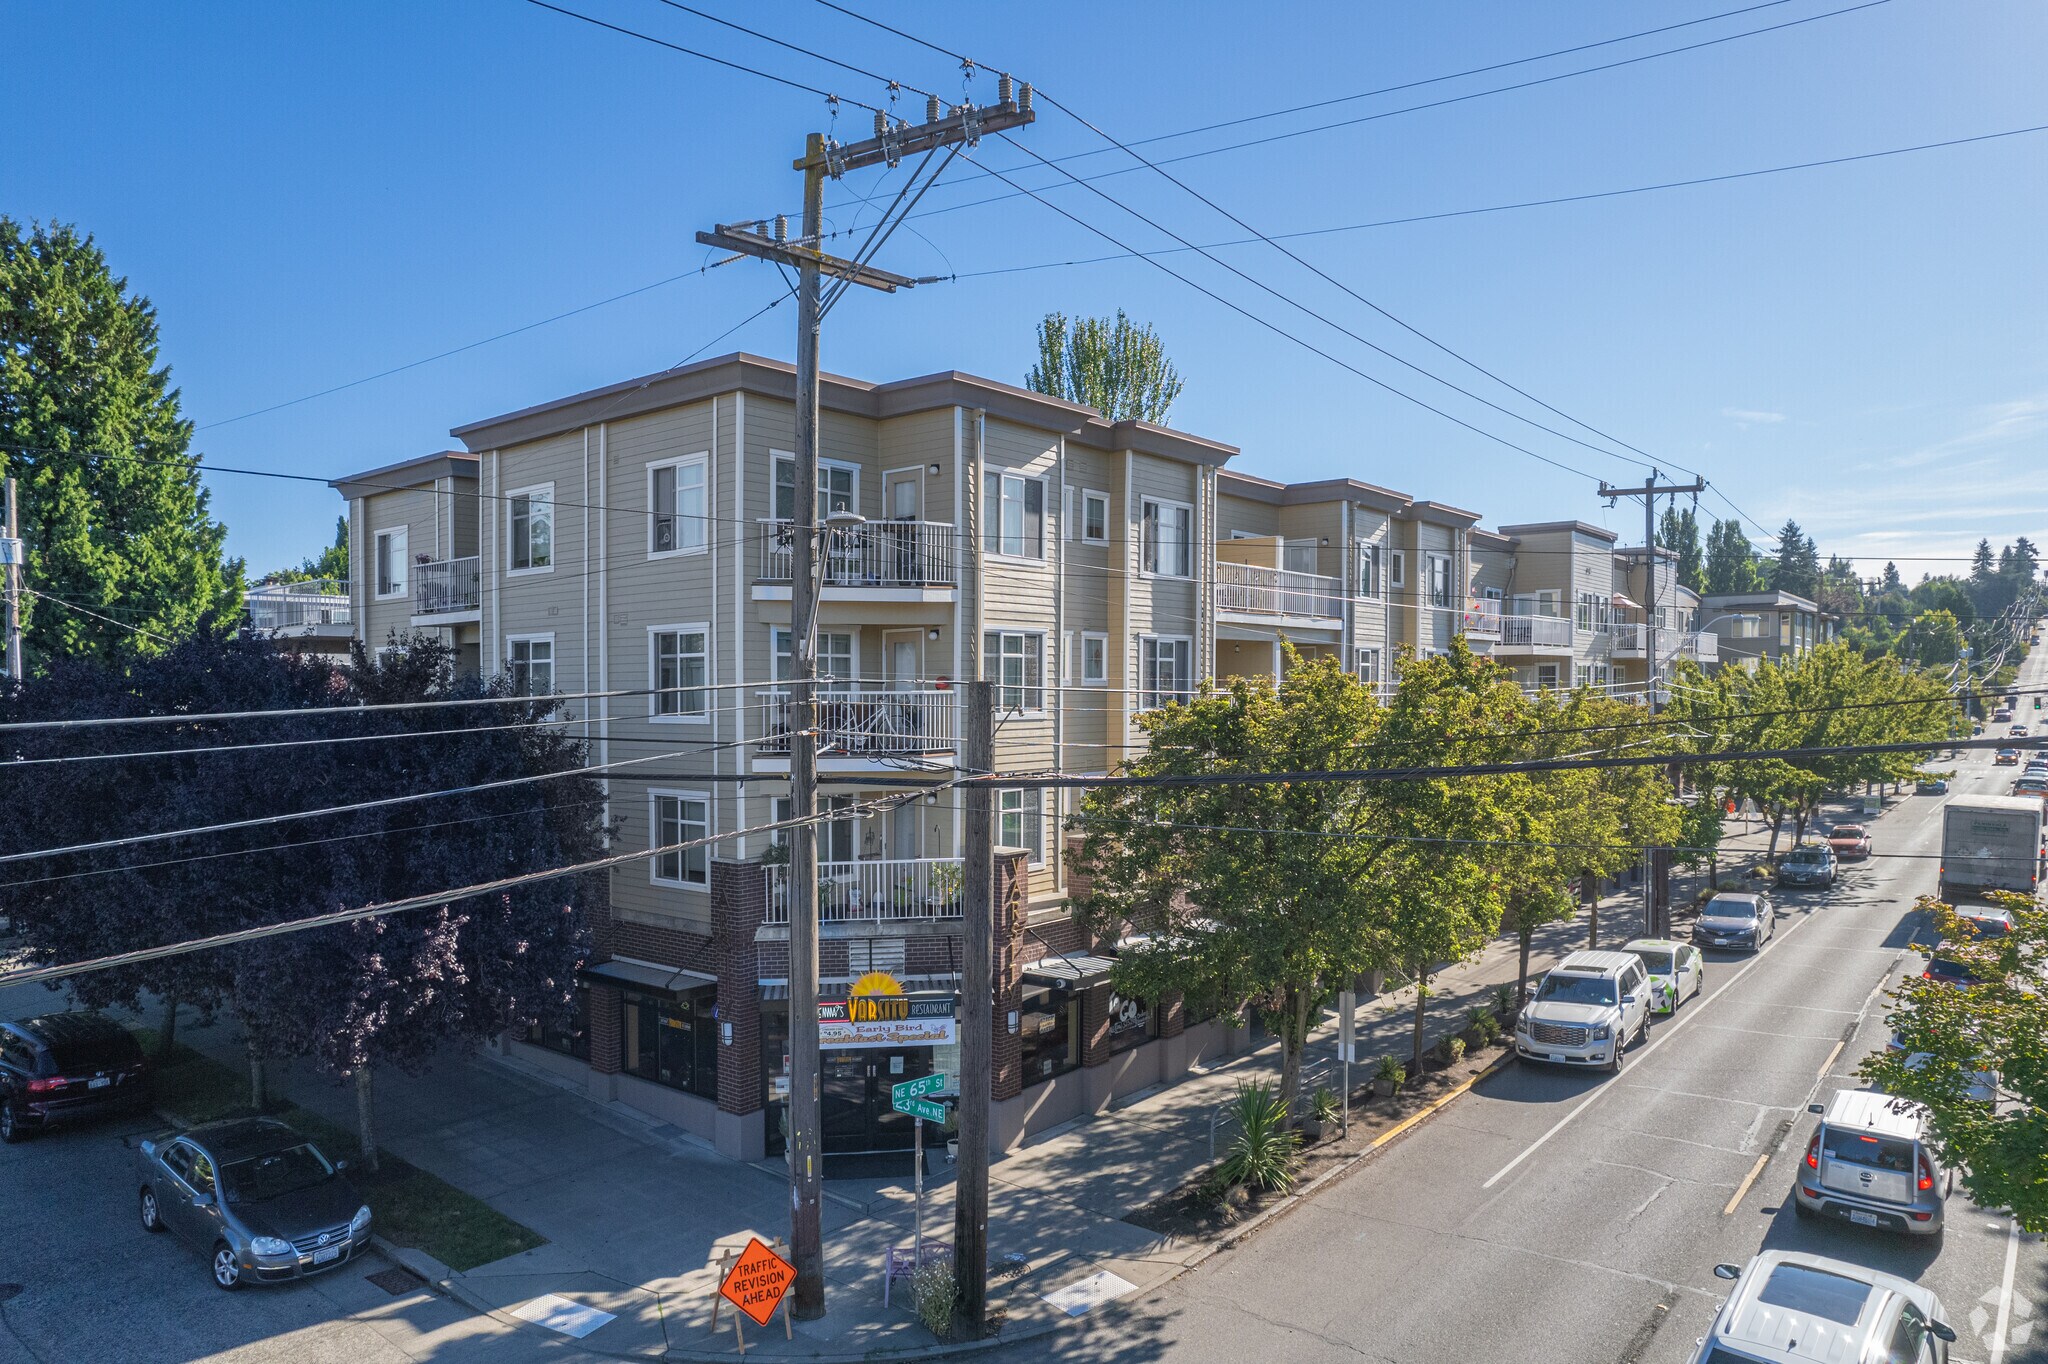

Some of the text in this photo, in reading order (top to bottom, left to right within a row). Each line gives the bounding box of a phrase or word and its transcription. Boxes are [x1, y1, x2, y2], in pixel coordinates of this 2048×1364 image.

[847, 997, 908, 1025] VARSITY
[911, 1003, 950, 1015] RESTAURANT
[819, 1030, 949, 1044] reakfast Special
[856, 1024, 923, 1034] Early Bird
[895, 1078, 943, 1098] NE 65th St
[917, 1103, 930, 1115] Ave
[932, 1107, 943, 1119] NE
[738, 1257, 777, 1277] TRAFFIC
[733, 1270, 785, 1293] REVISION
[742, 1286, 780, 1306] AHEAD
